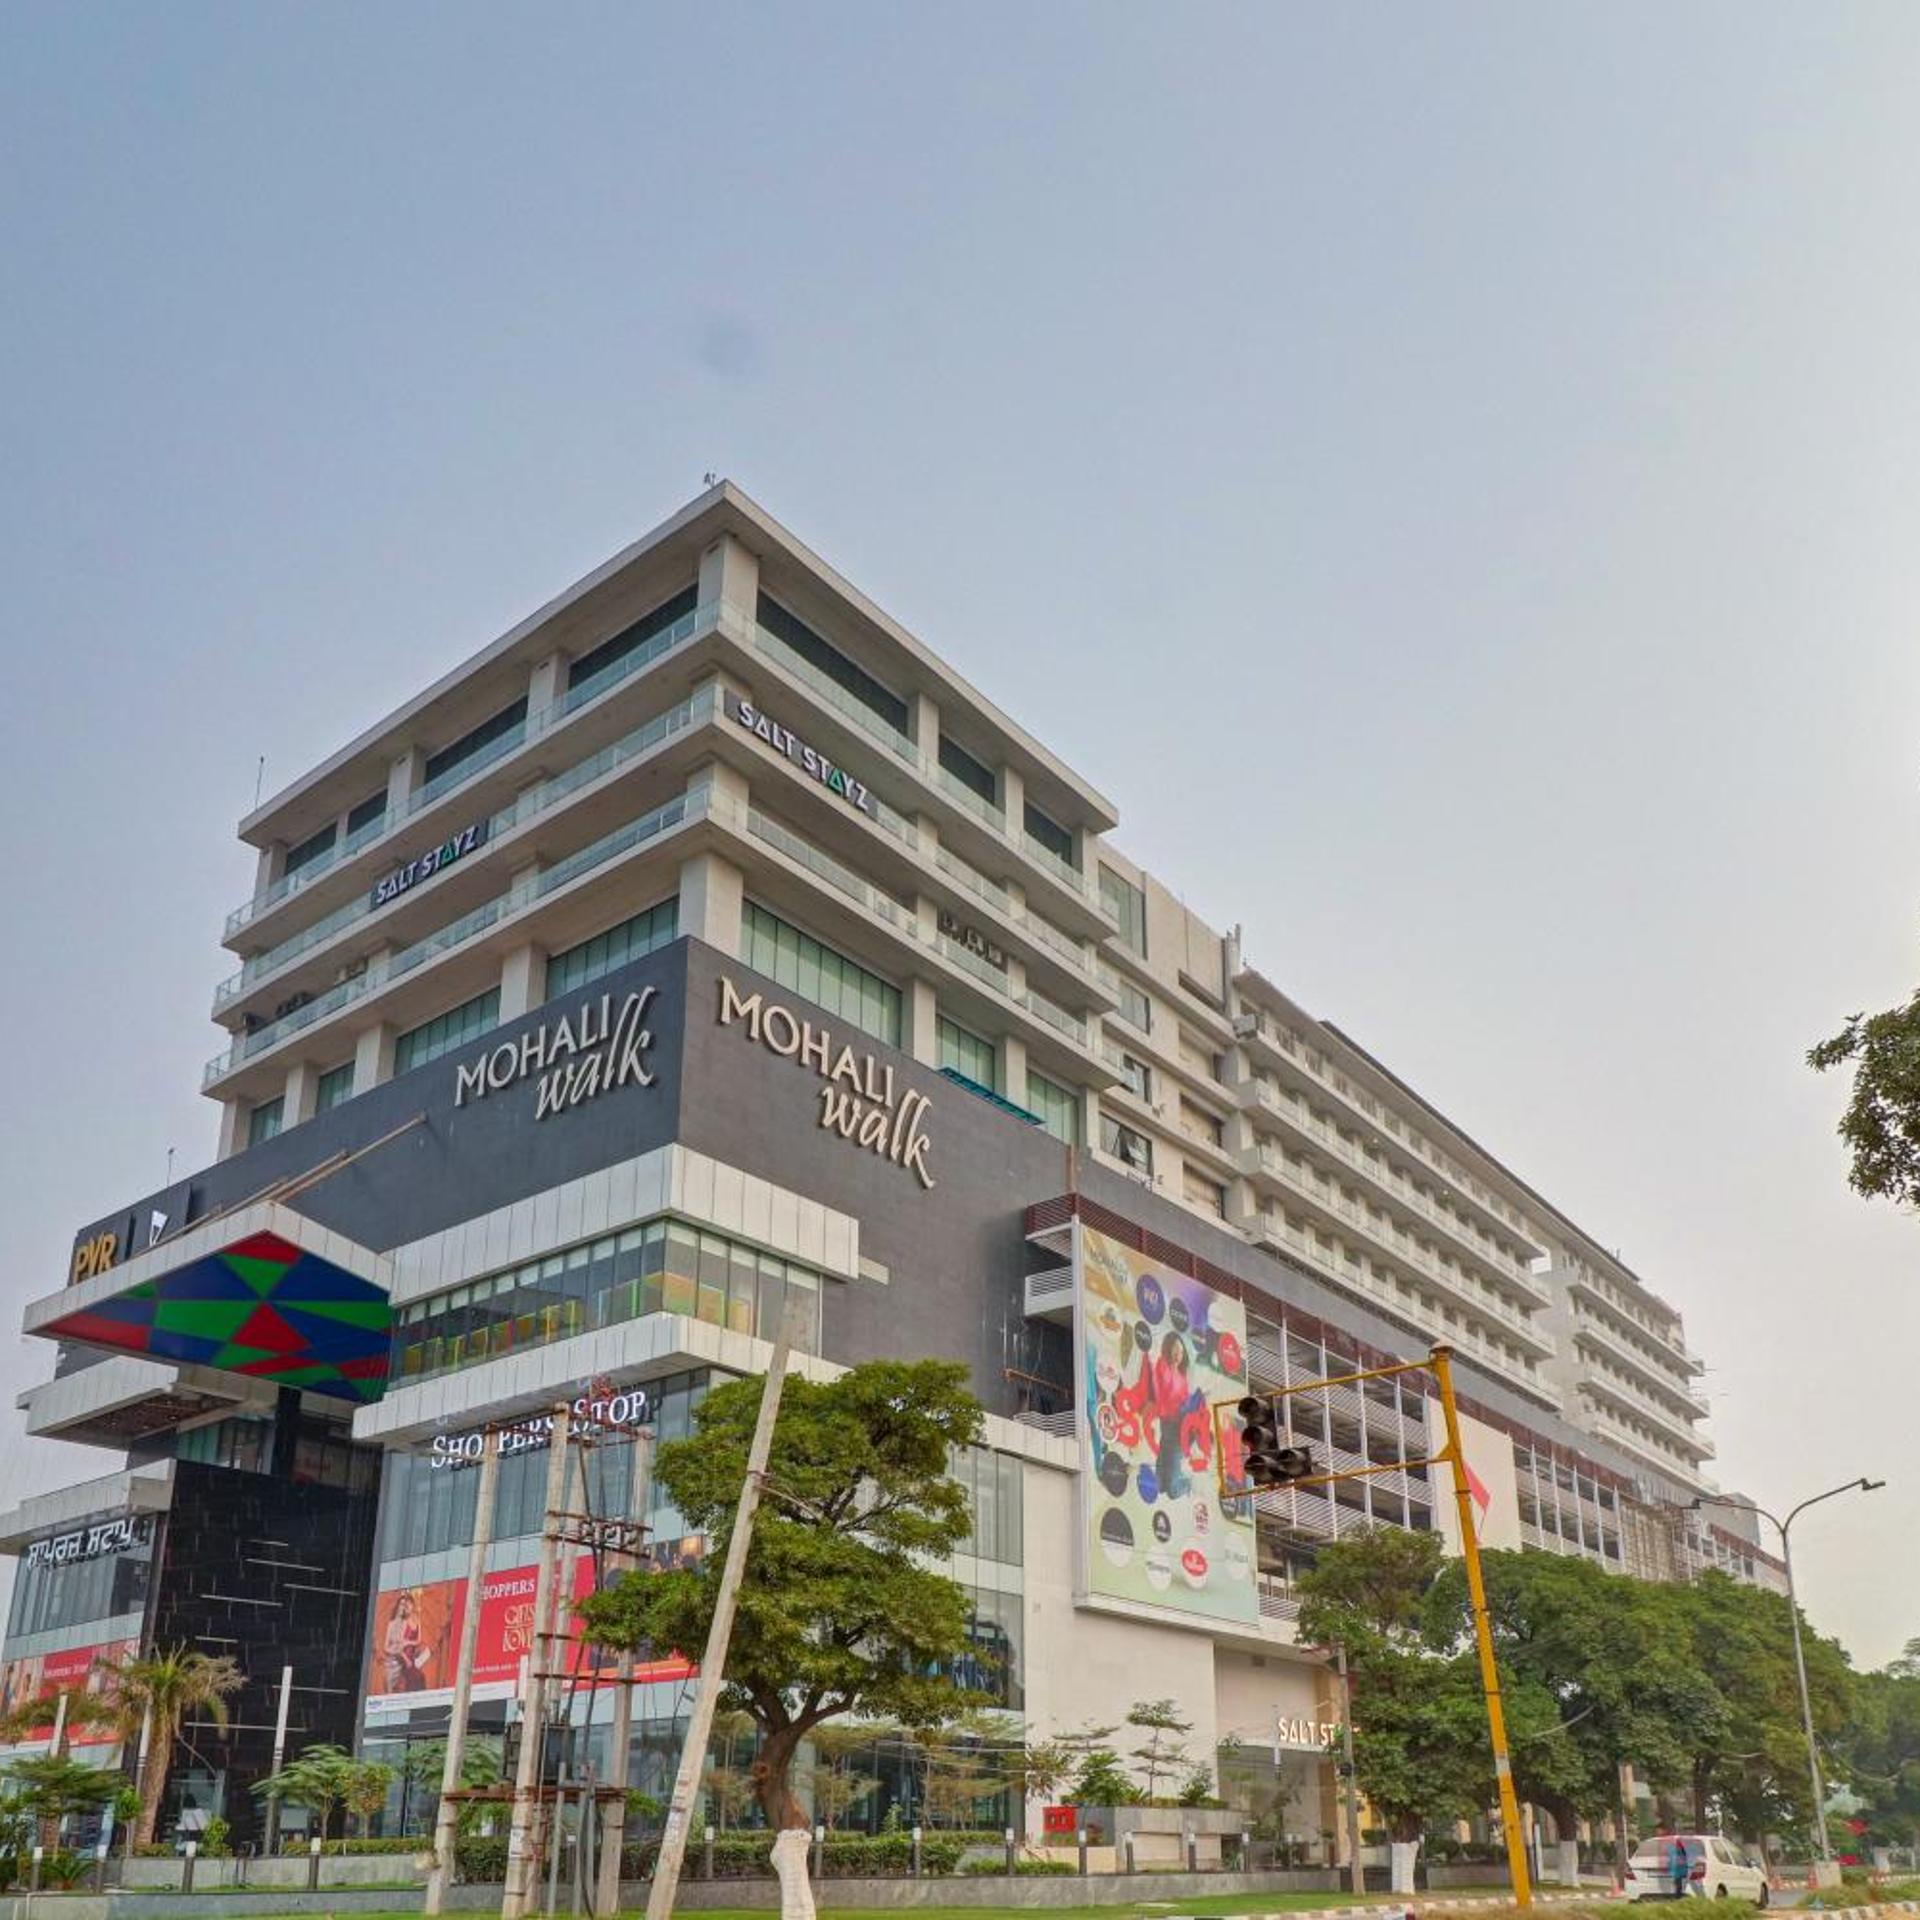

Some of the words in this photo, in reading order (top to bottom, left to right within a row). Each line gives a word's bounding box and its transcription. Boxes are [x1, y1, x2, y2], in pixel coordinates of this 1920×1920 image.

[739, 701, 796, 756] SALT
[802, 746, 869, 811] STAYZ
[376, 860, 418, 904] SALT
[420, 825, 477, 877] STAYZ
[454, 992, 610, 1107] MOHALI
[535, 985, 656, 1121] walk
[720, 975, 894, 1109] MOHALI
[821, 1087, 936, 1189] walk
[73, 1231, 117, 1283] PVR
[1278, 1716, 1315, 1744] SALT
